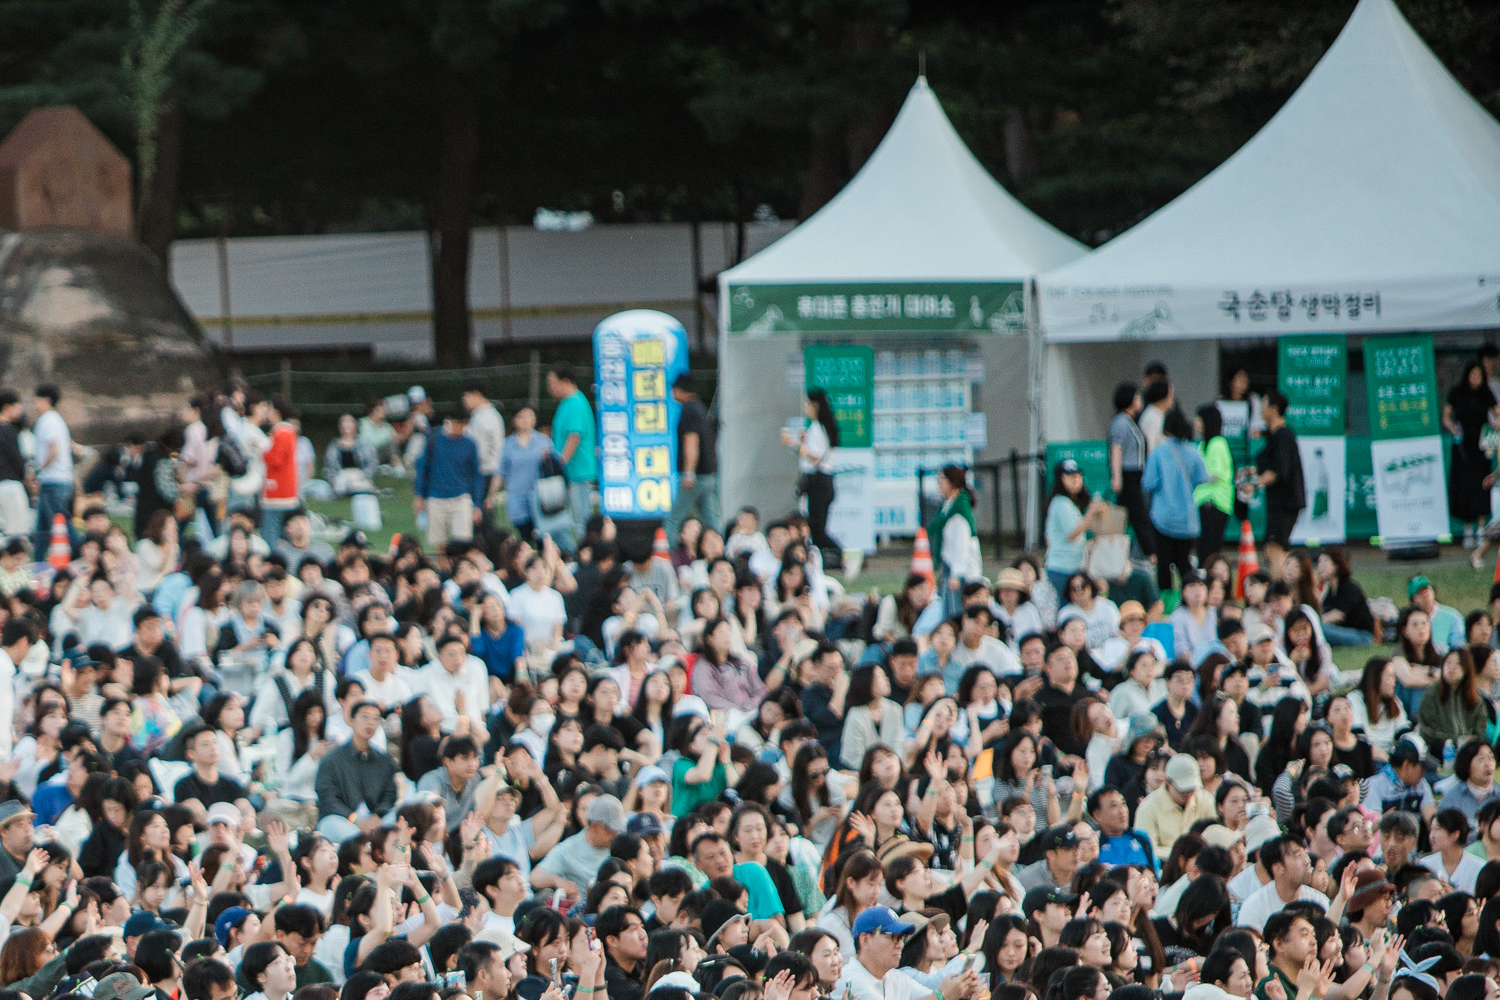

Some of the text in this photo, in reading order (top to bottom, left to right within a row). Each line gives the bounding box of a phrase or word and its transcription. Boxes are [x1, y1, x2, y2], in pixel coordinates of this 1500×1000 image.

[851, 294, 901, 319] 충전기
[1218, 289, 1382, 322] 국순당 생막걸리
[635, 445, 672, 513] 대여
